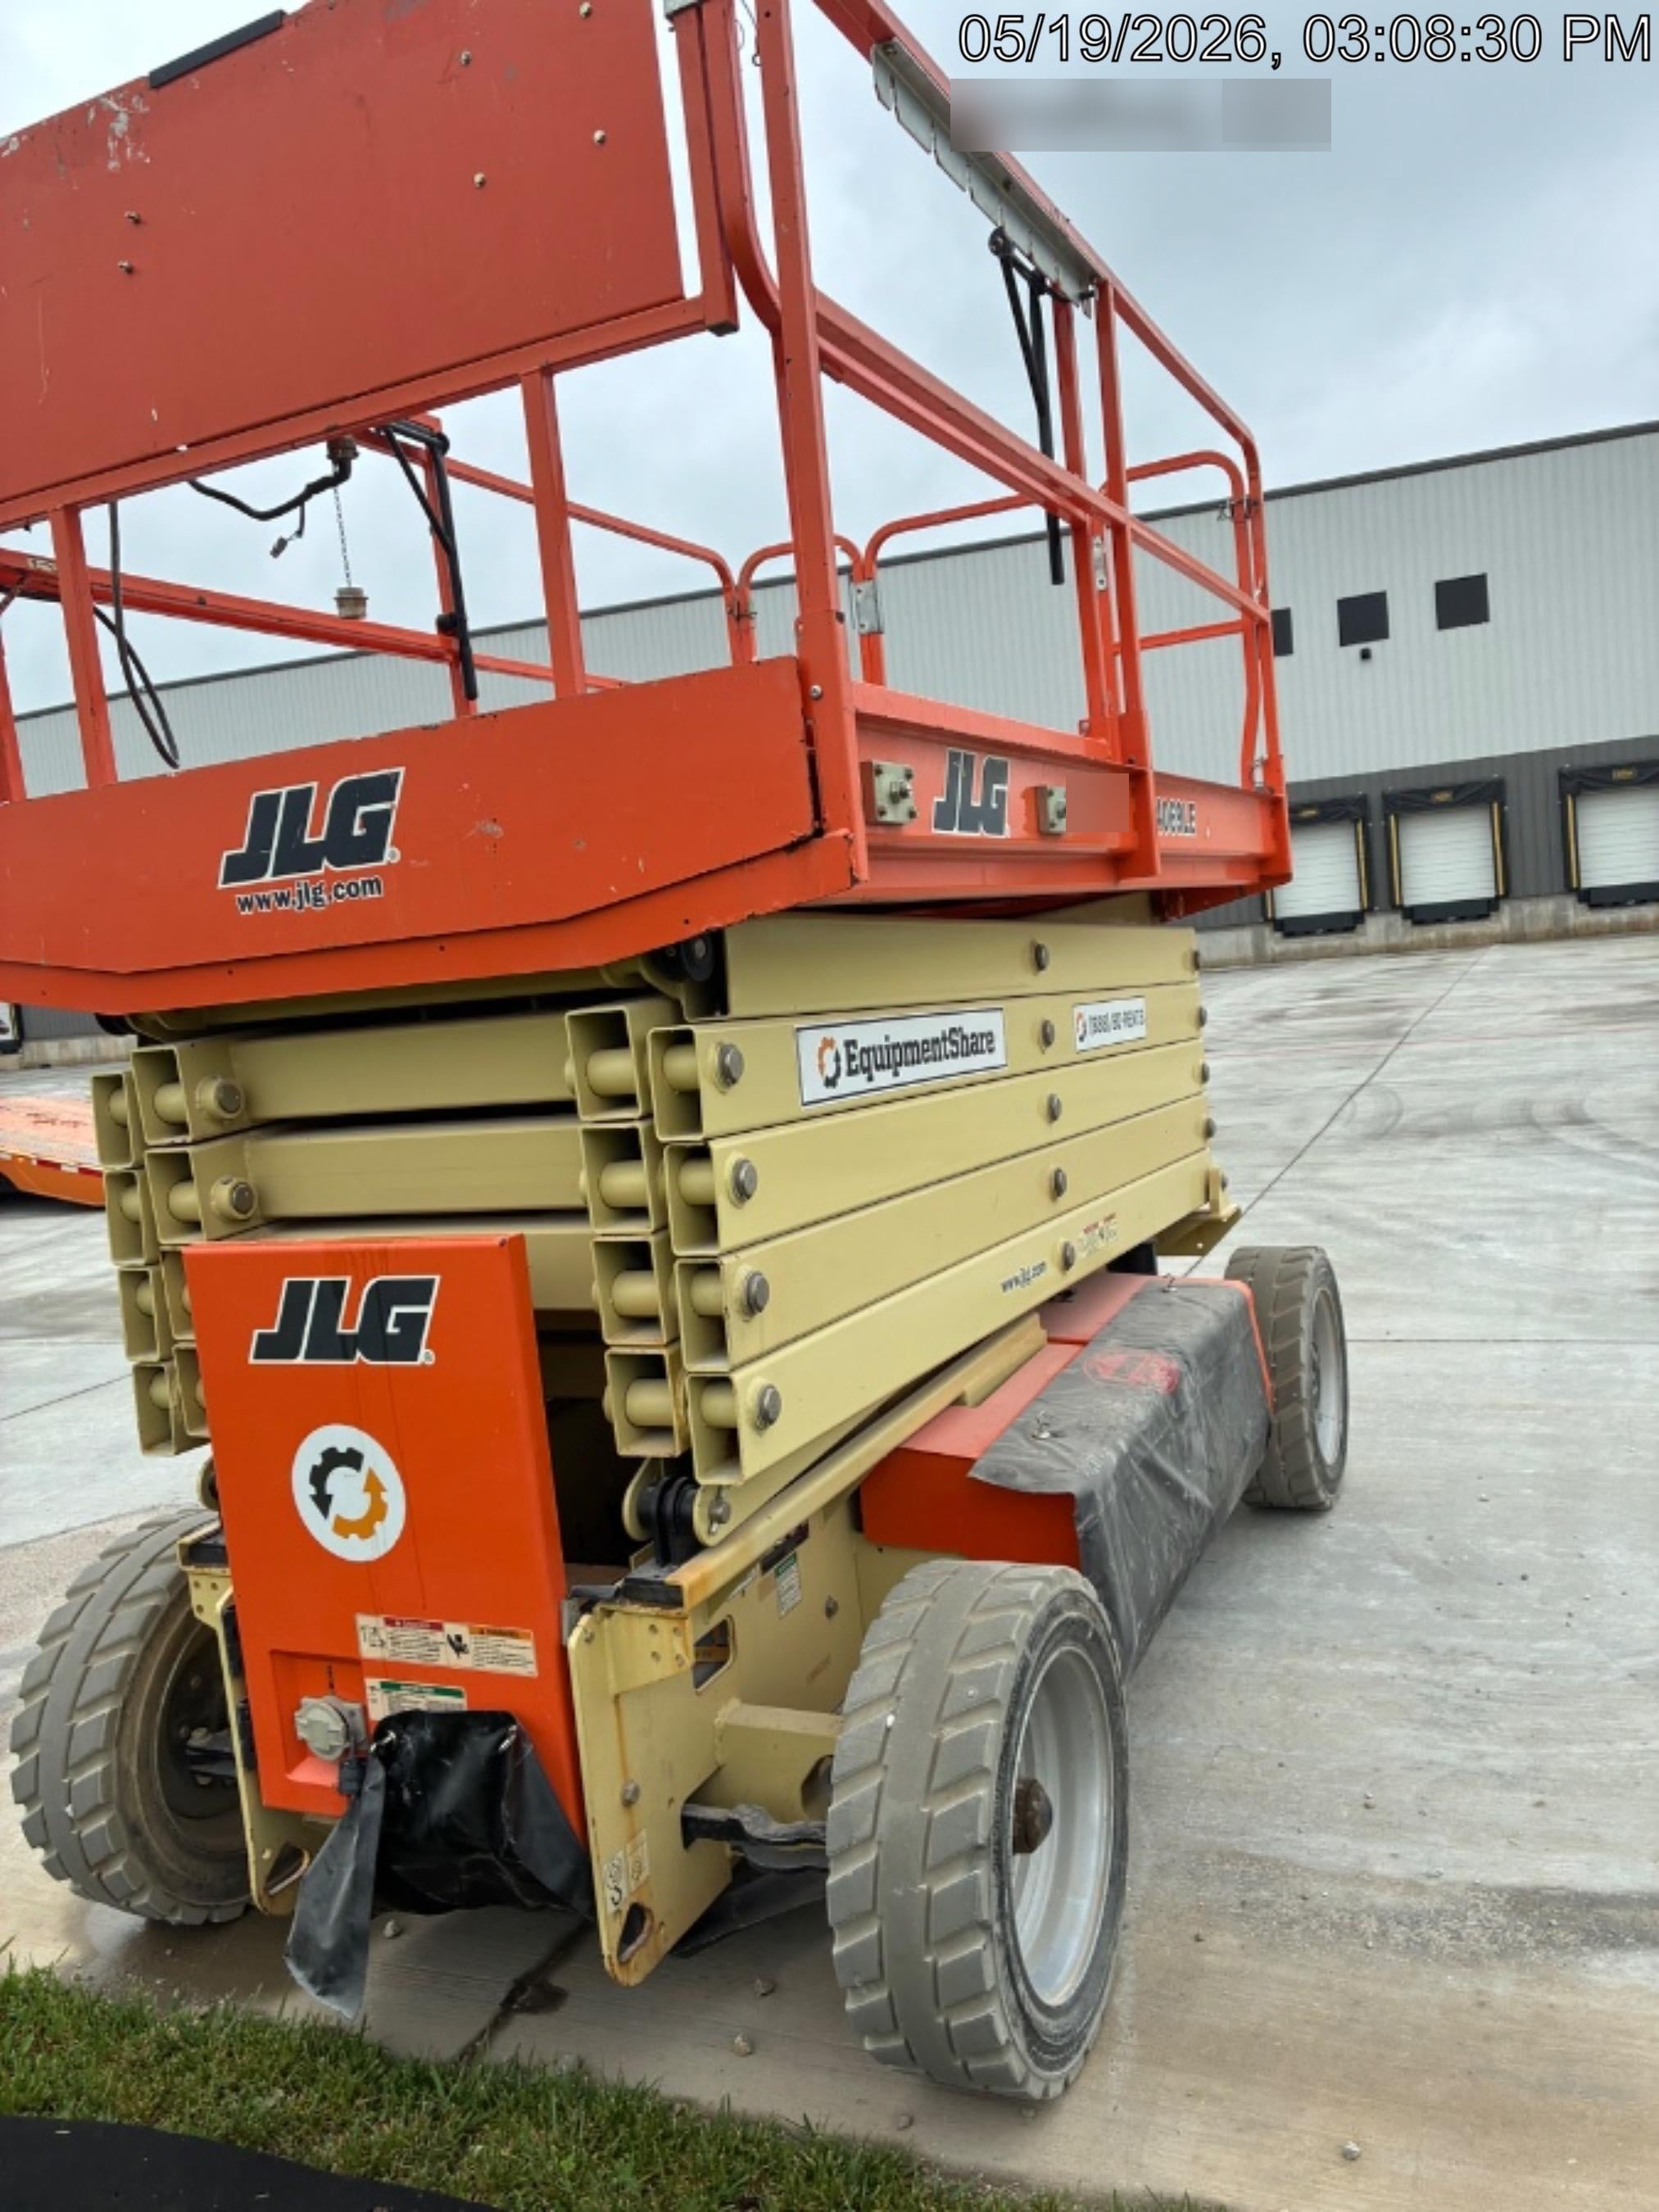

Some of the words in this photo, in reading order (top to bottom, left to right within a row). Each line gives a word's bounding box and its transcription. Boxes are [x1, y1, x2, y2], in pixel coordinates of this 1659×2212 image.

[218, 767, 406, 890] JLG
[931, 746, 1011, 838] JLG
[236, 875, 383, 914] www.jlg.com
[843, 1026, 996, 1082] EquipmentShare
[248, 1275, 440, 1365] JLG
